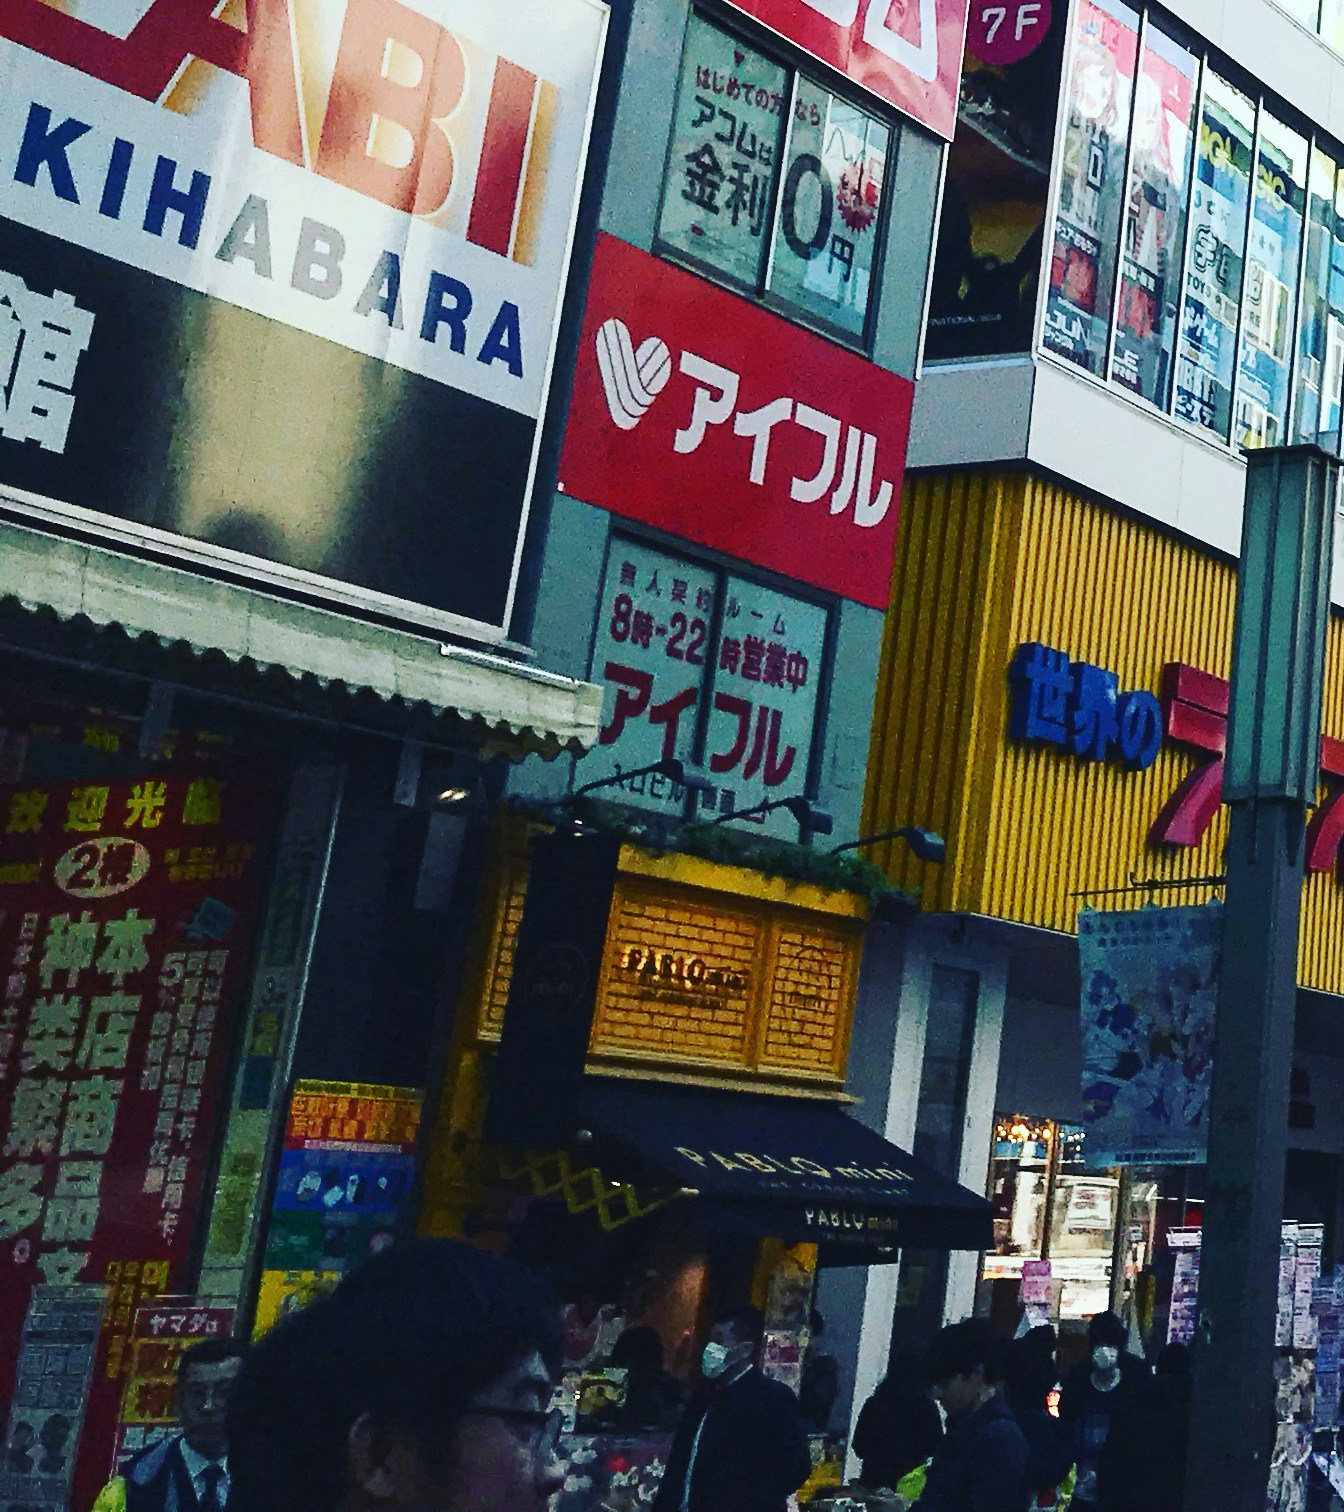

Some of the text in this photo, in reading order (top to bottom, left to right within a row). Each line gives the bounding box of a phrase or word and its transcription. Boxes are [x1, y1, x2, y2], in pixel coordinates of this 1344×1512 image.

[981, 1, 1043, 43] 7F
[672, 349, 894, 529] アイフル
[599, 661, 796, 787] アイフル
[1009, 641, 1163, 773] 世界の
[672, 1145, 916, 1181] PABLO mini
